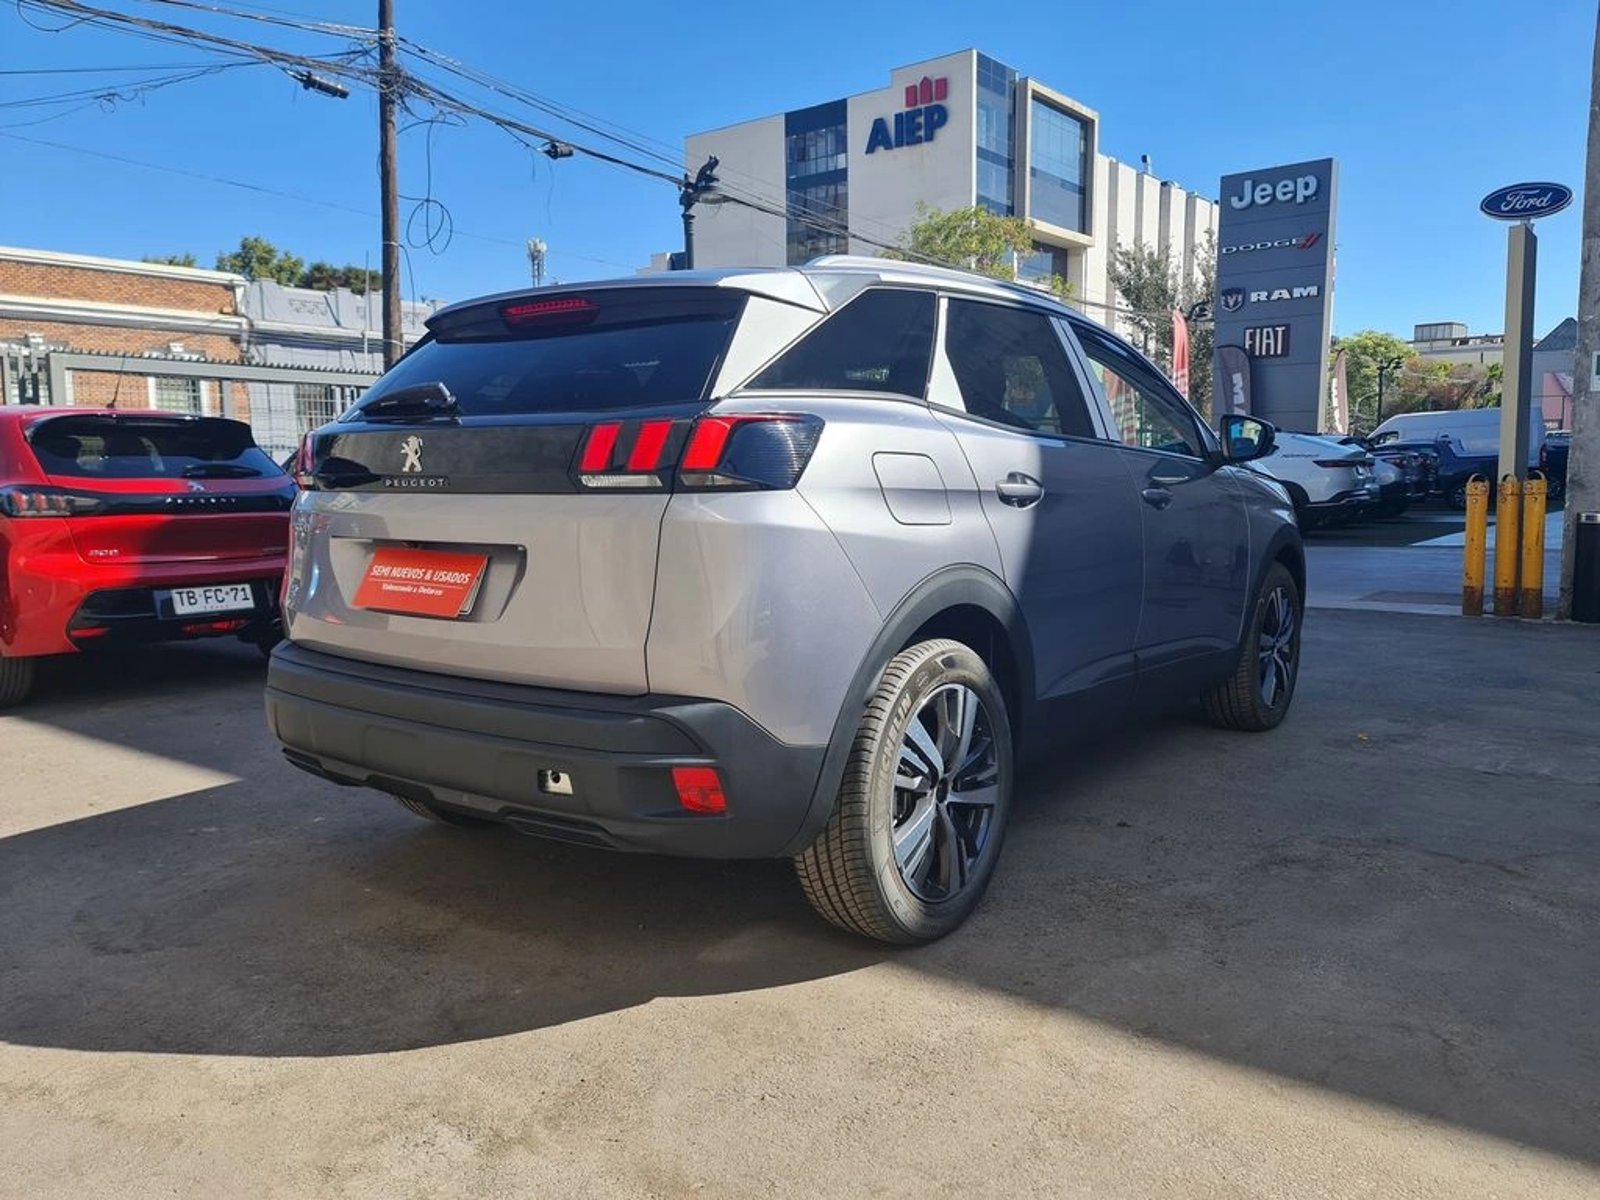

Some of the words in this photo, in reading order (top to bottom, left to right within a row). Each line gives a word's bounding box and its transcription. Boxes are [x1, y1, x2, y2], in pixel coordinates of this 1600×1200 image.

[865, 104, 948, 154] AIEP
[1230, 174, 1318, 209] Jeep
[1501, 189, 1553, 211] Ford
[1222, 238, 1305, 254] DODGE
[1251, 286, 1318, 303] RAM
[1244, 326, 1286, 356] FIAT
[385, 478, 445, 487] PEUGEOT
[371, 565, 392, 576] SEMI
[391, 567, 425, 580] NUEVOS
[424, 570, 434, 580] &
[433, 571, 471, 584] USADOS
[877, 693, 911, 792] MICHELIN
